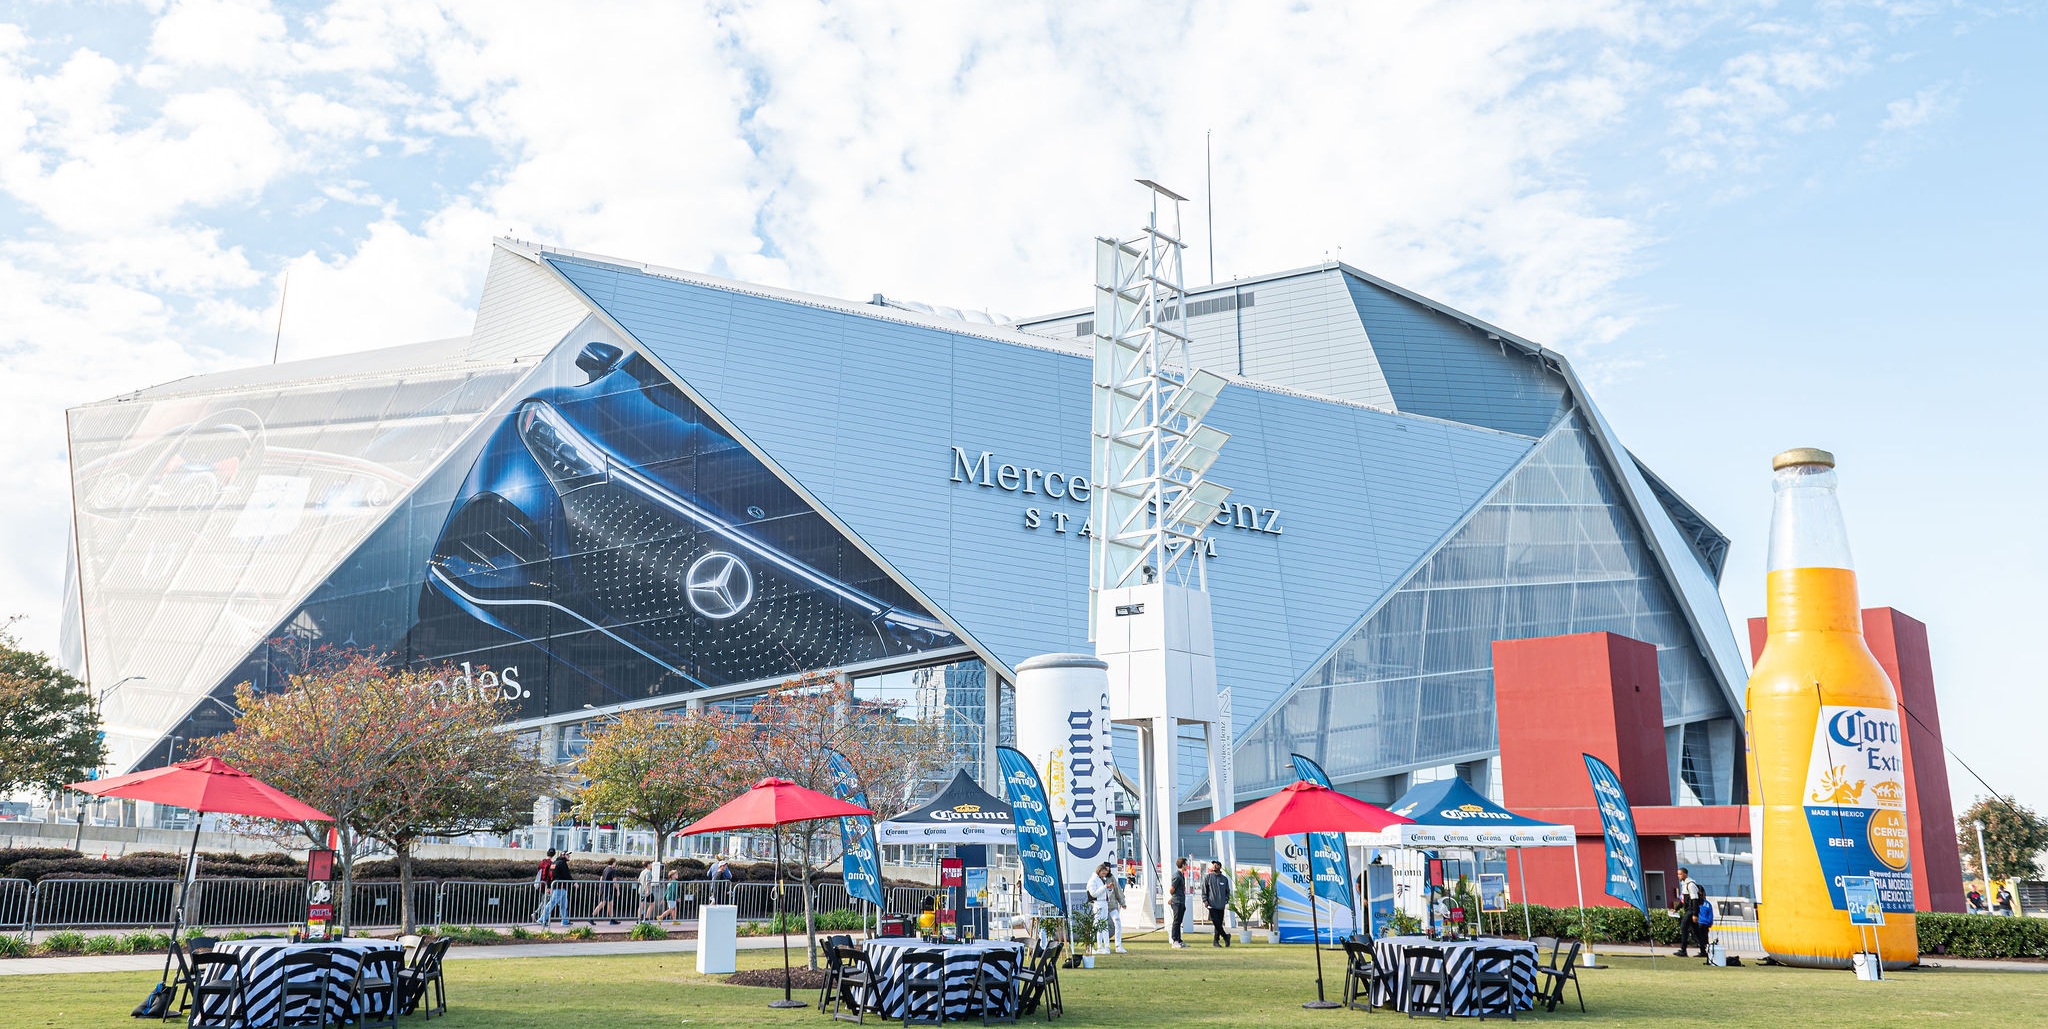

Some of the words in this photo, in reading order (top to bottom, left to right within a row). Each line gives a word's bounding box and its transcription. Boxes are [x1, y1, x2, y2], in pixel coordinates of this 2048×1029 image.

[950, 446, 1283, 535] Merceenz
[1025, 507, 1219, 558] STAM
[1828, 709, 1899, 752] Coro
[1062, 708, 1106, 859] Corona
[929, 809, 1009, 822] Corona
[1440, 808, 1513, 820] Corona
[1840, 810, 1865, 818] MEXICO
[1888, 817, 1899, 826] LA
[885, 828, 909, 836] Corona
[923, 827, 947, 836] Corona
[962, 827, 985, 835] Corona
[1000, 828, 1016, 836] Coro
[1411, 833, 1436, 842] Corona
[1443, 834, 1469, 842] Corona
[1476, 833, 1502, 842] Corona
[1509, 834, 1535, 842] Corona
[1542, 833, 1568, 842] Corona
[1828, 837, 1854, 848] BEER
[1886, 839, 1904, 848] MAS
[1887, 849, 1905, 859] FINA
[1282, 863, 1298, 872] RISE
[1394, 869, 1422, 877] orona
[1292, 873, 1311, 884] RAIS
[1849, 902, 1866, 914] 21+
